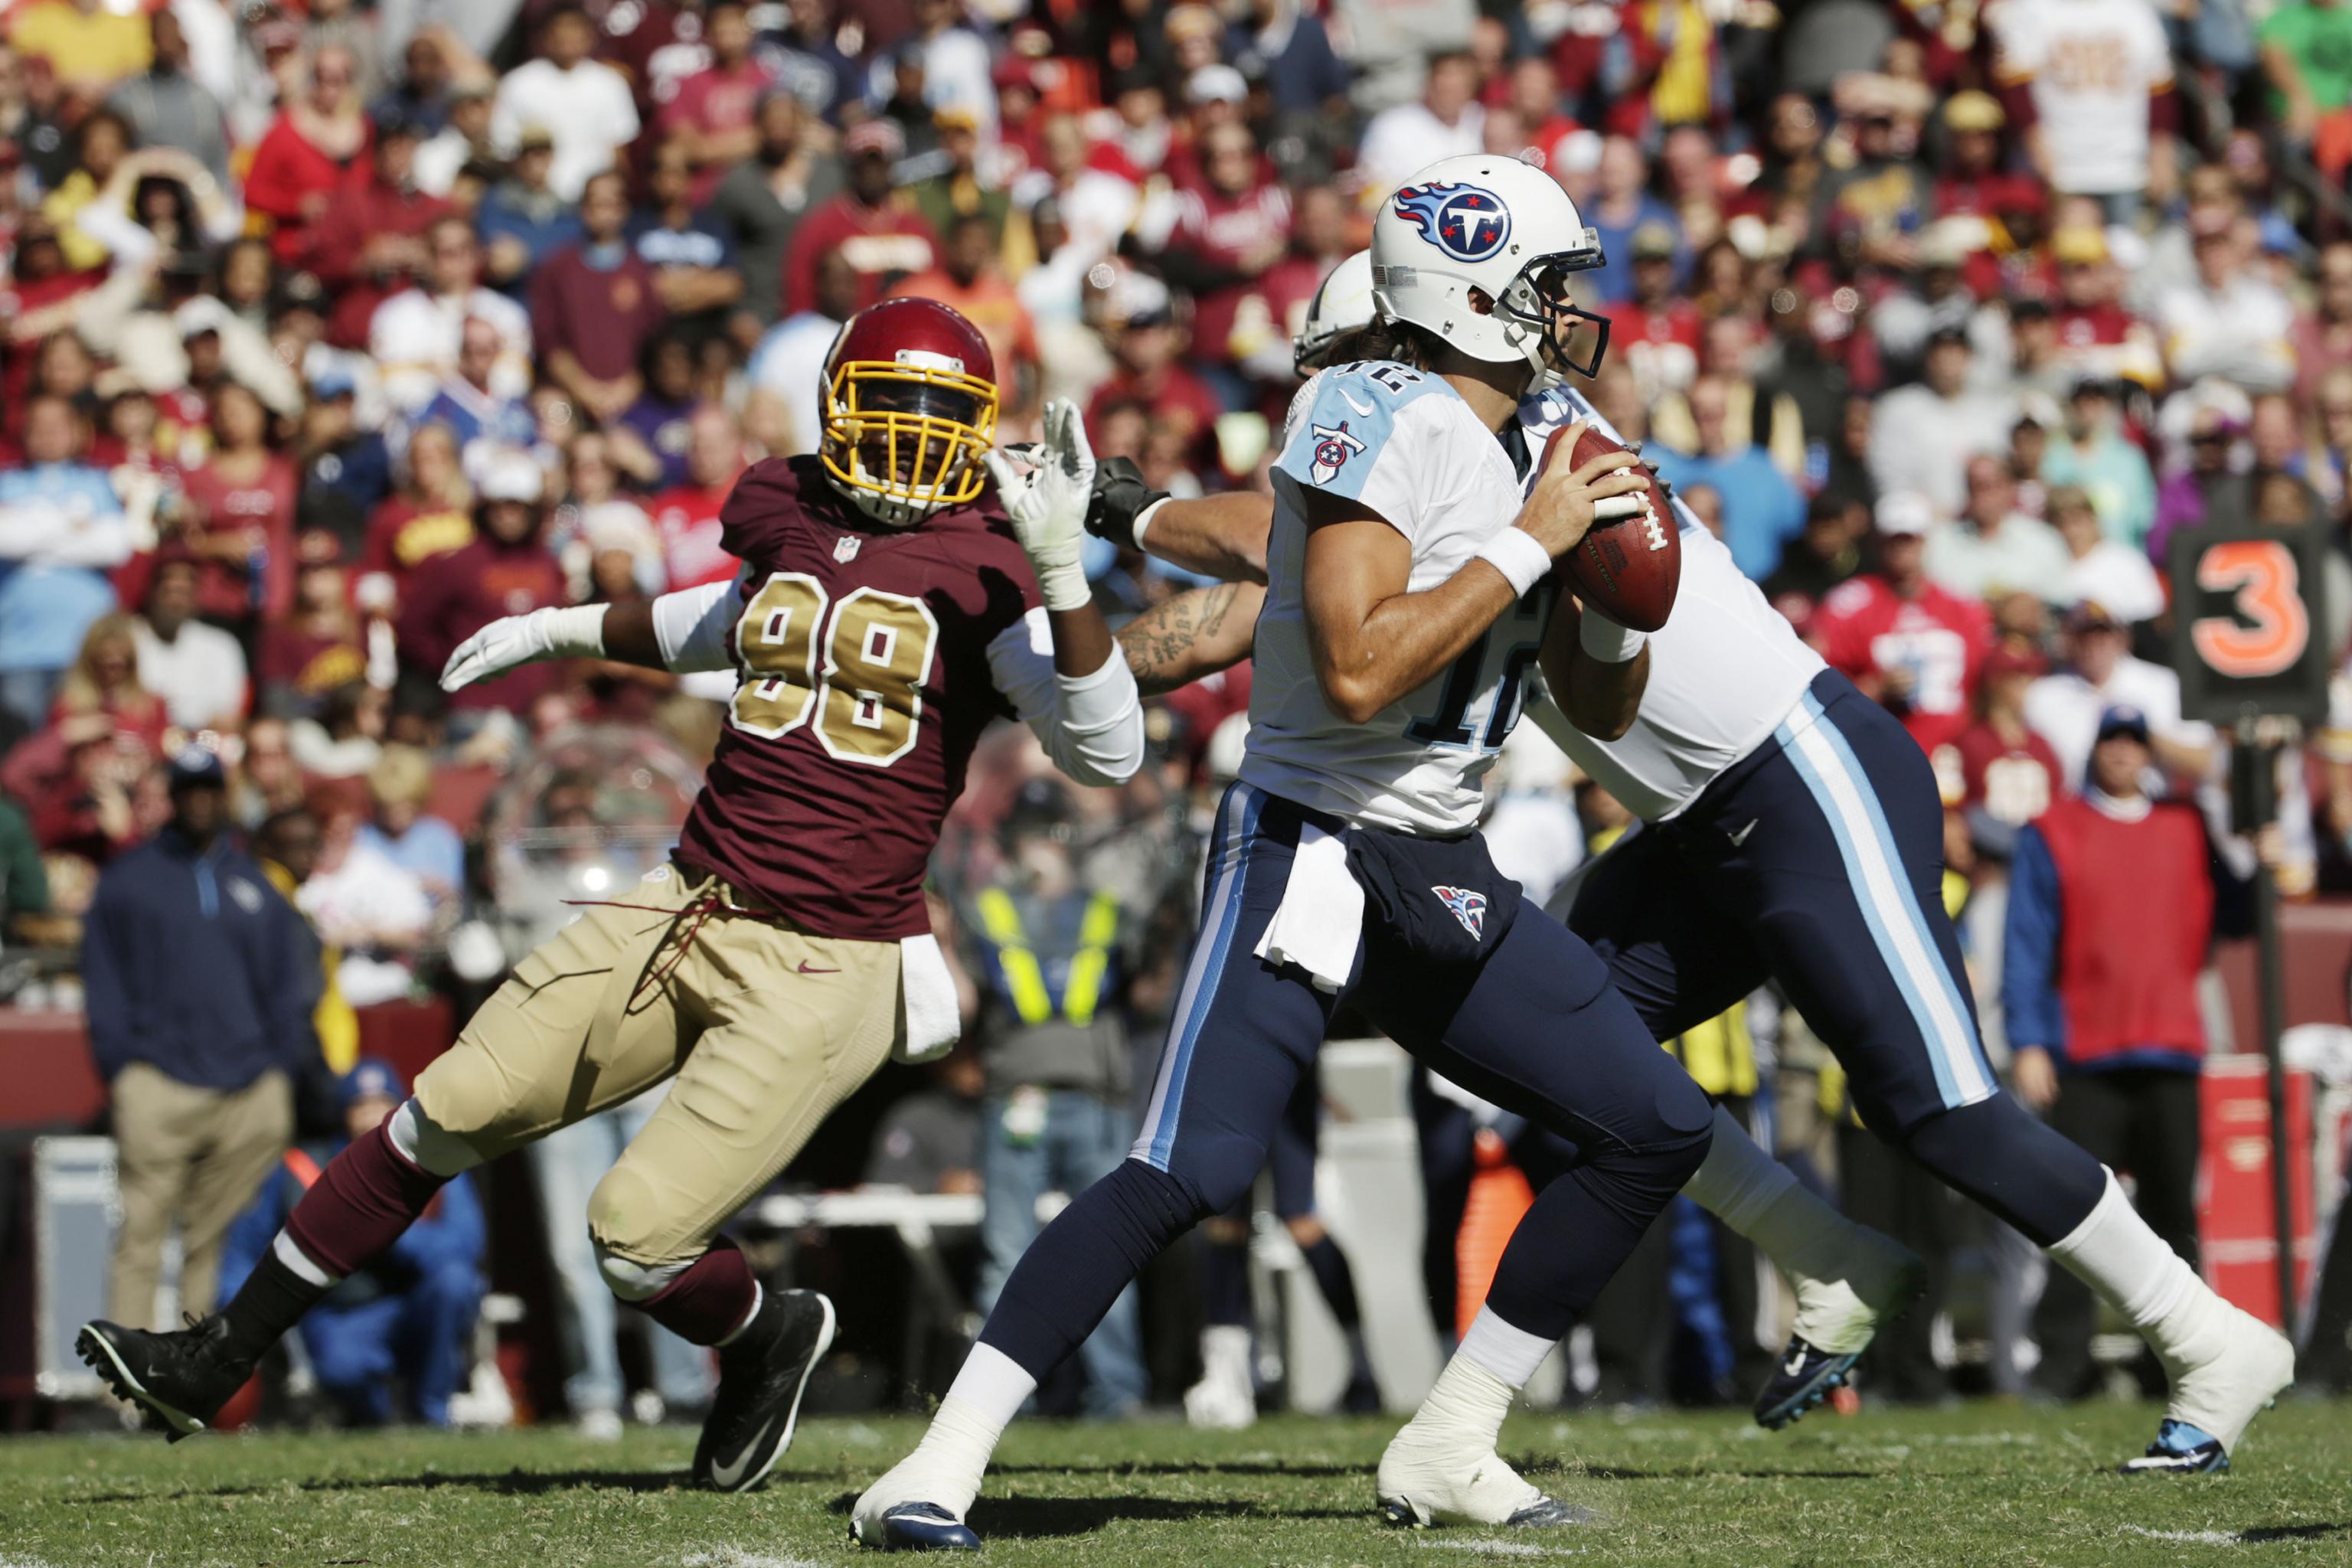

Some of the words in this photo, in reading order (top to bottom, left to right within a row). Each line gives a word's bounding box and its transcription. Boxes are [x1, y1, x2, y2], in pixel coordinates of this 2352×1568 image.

[1446, 207, 1508, 251] T
[730, 572, 939, 767] 98
[2191, 540, 2309, 678] 3
